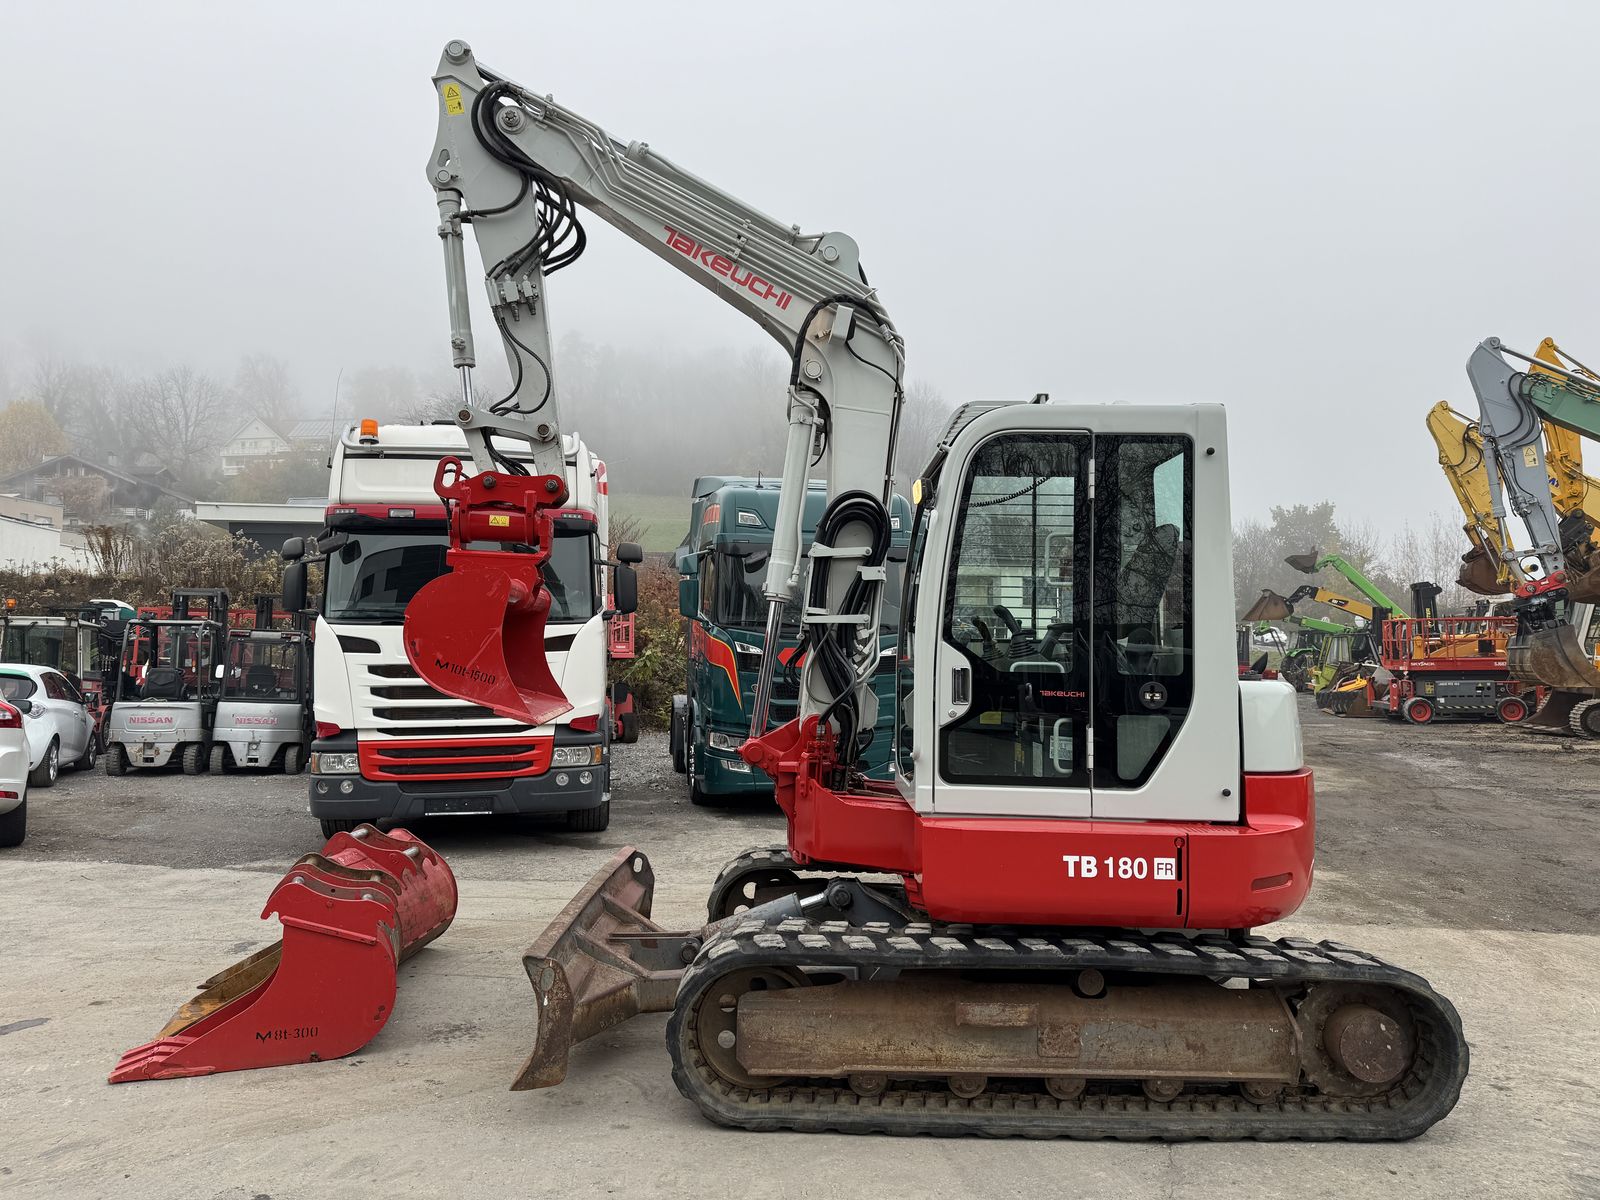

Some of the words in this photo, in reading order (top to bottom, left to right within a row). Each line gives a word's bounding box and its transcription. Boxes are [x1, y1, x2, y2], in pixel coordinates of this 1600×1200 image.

[664, 225, 792, 310] TAKEUCHI
[1040, 690, 1085, 698] TAKEUCHI
[129, 716, 173, 724] NISSAN
[235, 716, 278, 725] NISSAN
[1062, 855, 1098, 878] TB
[1104, 856, 1148, 879] 180
[1155, 861, 1174, 878] FR
[274, 1027, 318, 1040] 8t-300
